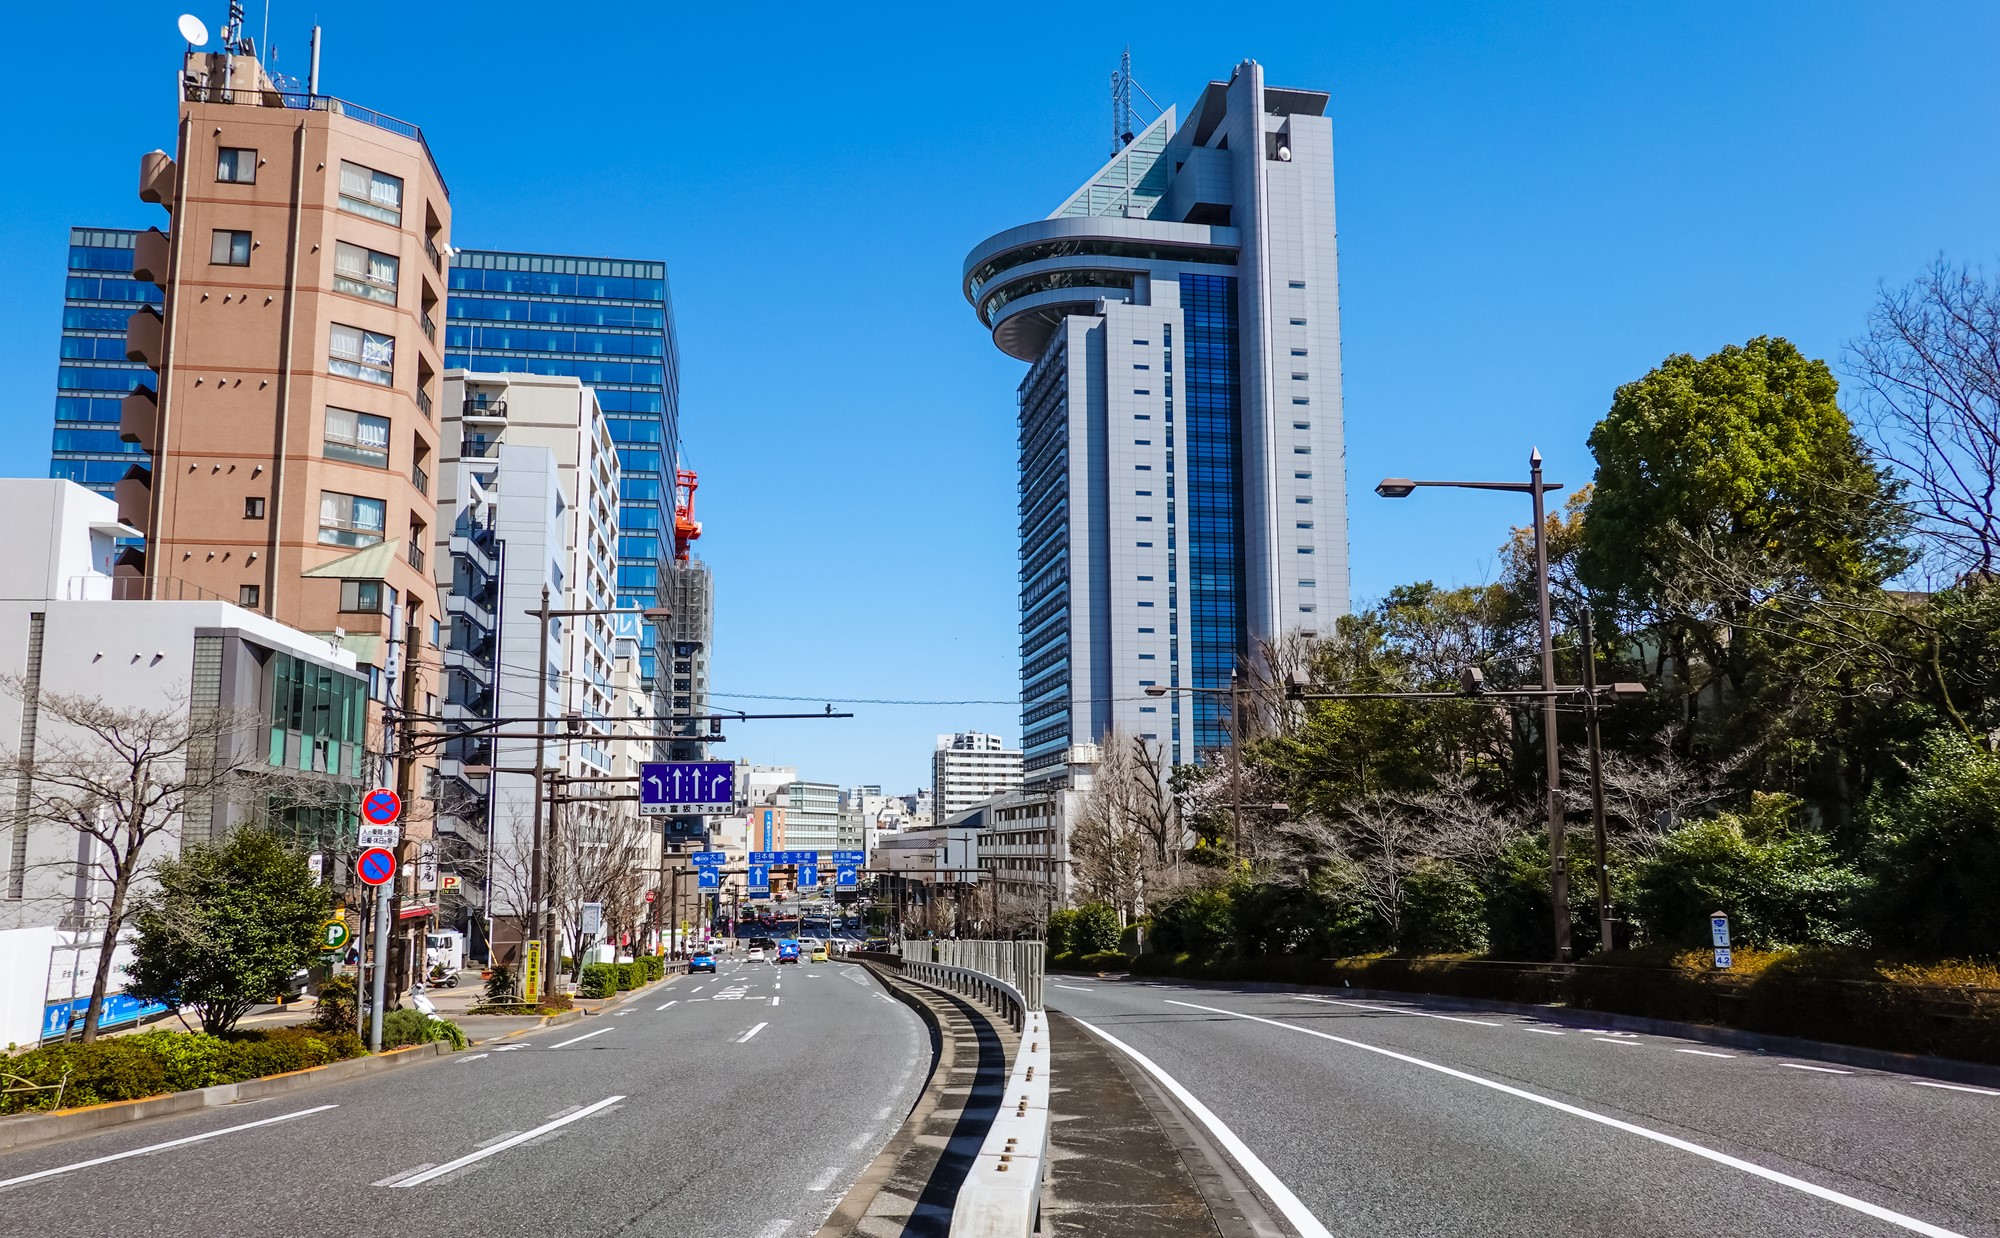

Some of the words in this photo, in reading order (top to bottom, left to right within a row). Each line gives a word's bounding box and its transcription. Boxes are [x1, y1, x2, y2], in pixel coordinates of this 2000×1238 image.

[642, 804, 732, 813] この先富坂下交差点
[754, 852, 775, 860] 日本橋
[444, 877, 455, 888] P
[328, 925, 343, 944] P
[528, 951, 537, 995] 自転車事故注意
